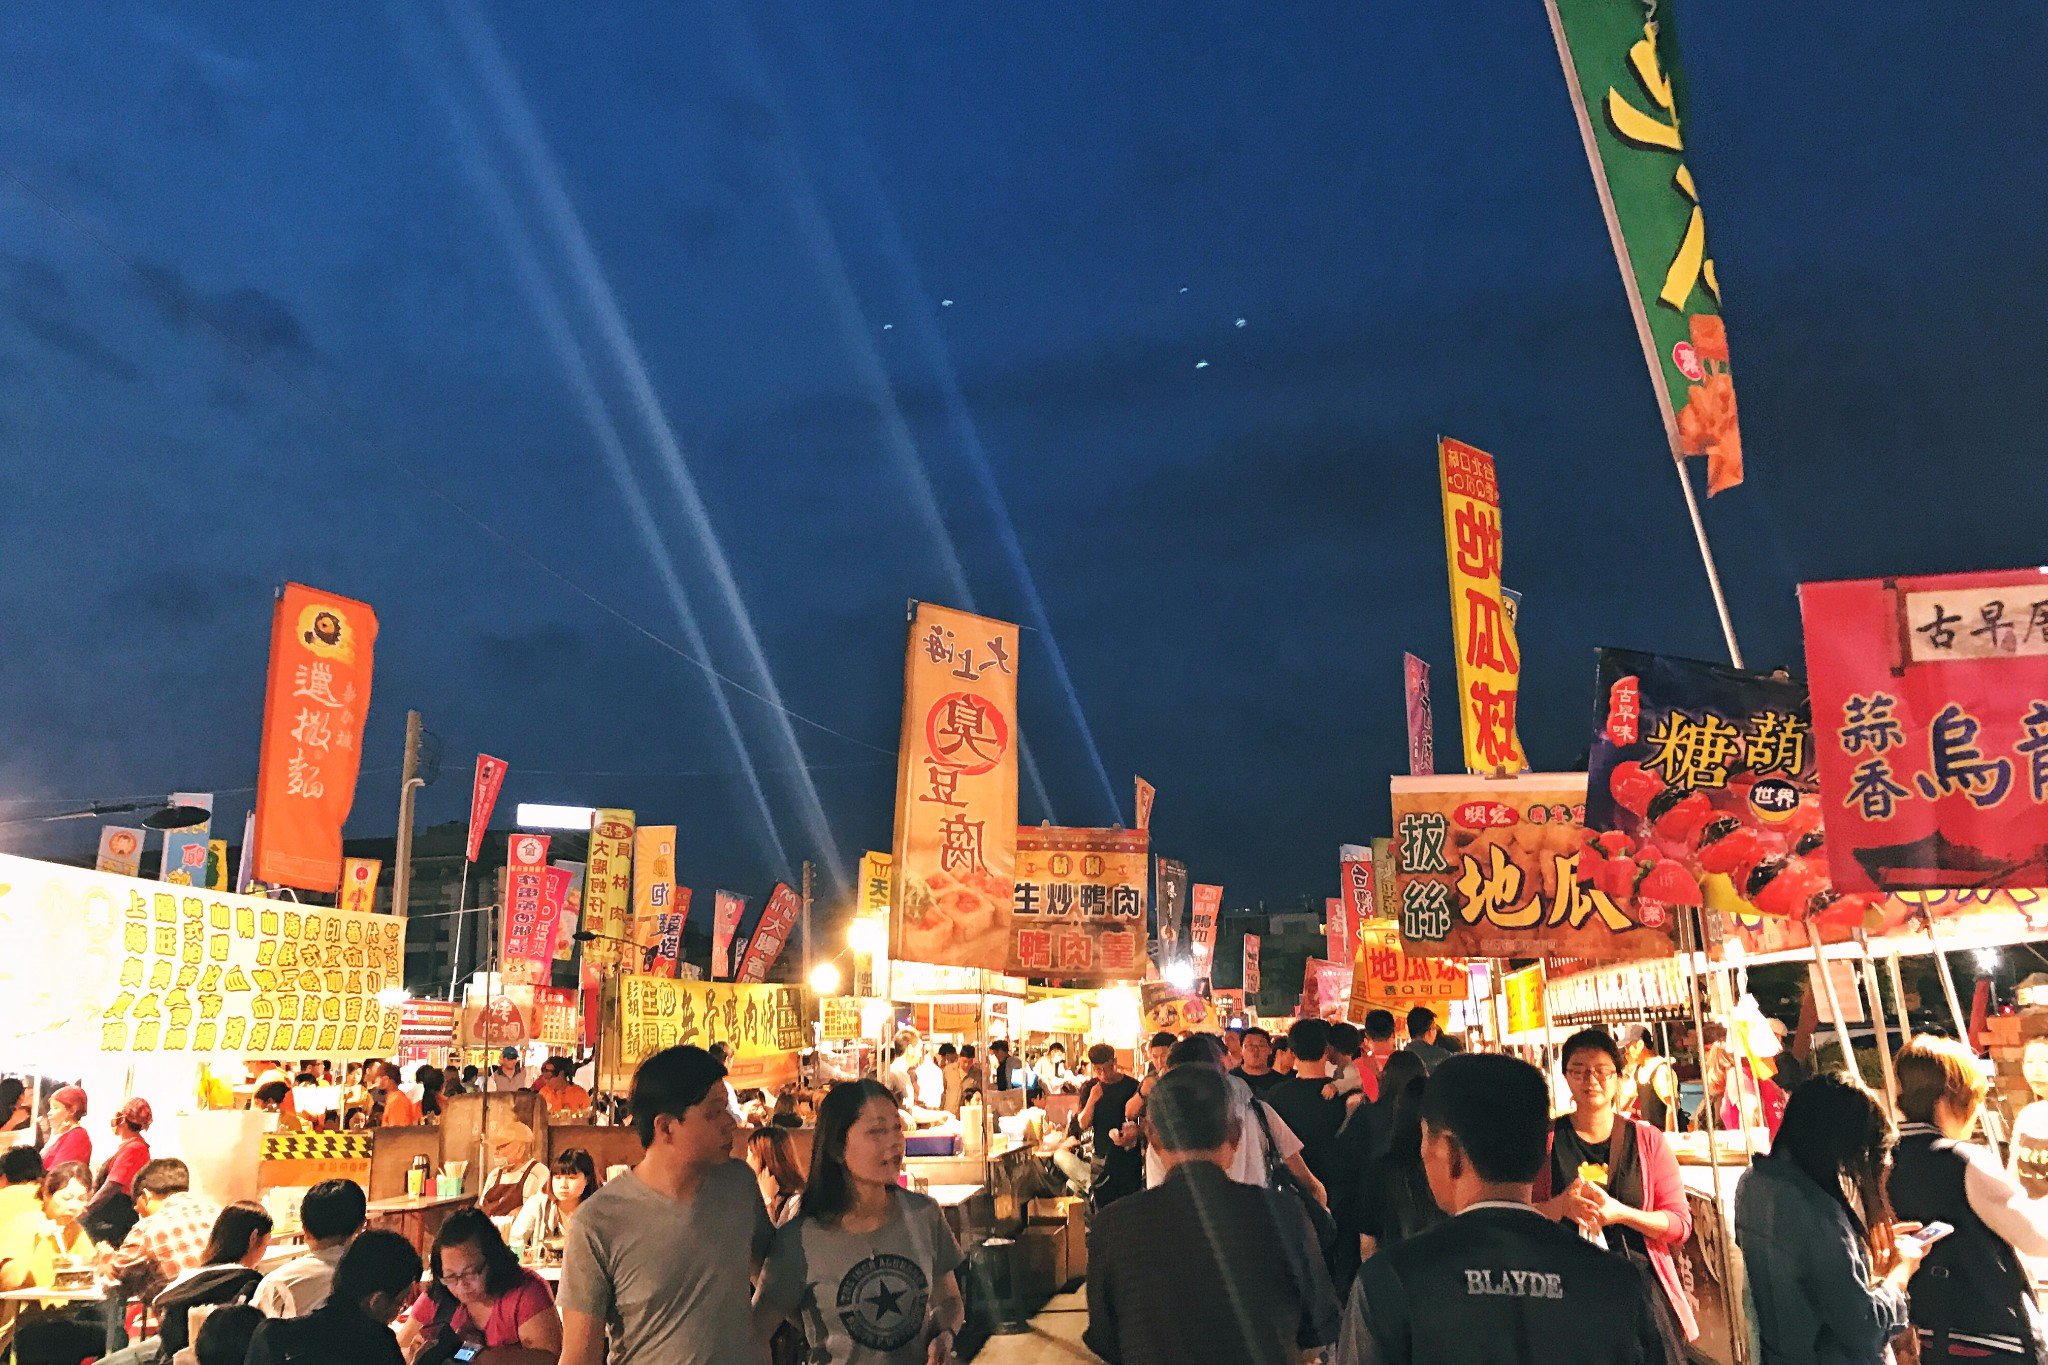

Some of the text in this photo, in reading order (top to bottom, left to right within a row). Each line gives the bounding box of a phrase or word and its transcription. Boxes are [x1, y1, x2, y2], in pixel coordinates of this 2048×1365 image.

[1612, 686, 1637, 741] 古早味
[1642, 711, 1820, 788] 糖葫
[1839, 690, 1914, 822] 蒜香
[1754, 786, 1797, 808] 世界
[1014, 882, 1141, 918] 生炒鴨肉
[1399, 813, 1451, 942] 拔絲
[1456, 842, 1638, 933] 地瓜
[1018, 929, 1135, 968] 鴨肉羹
[1464, 1268, 1564, 1299] BLAYDE
